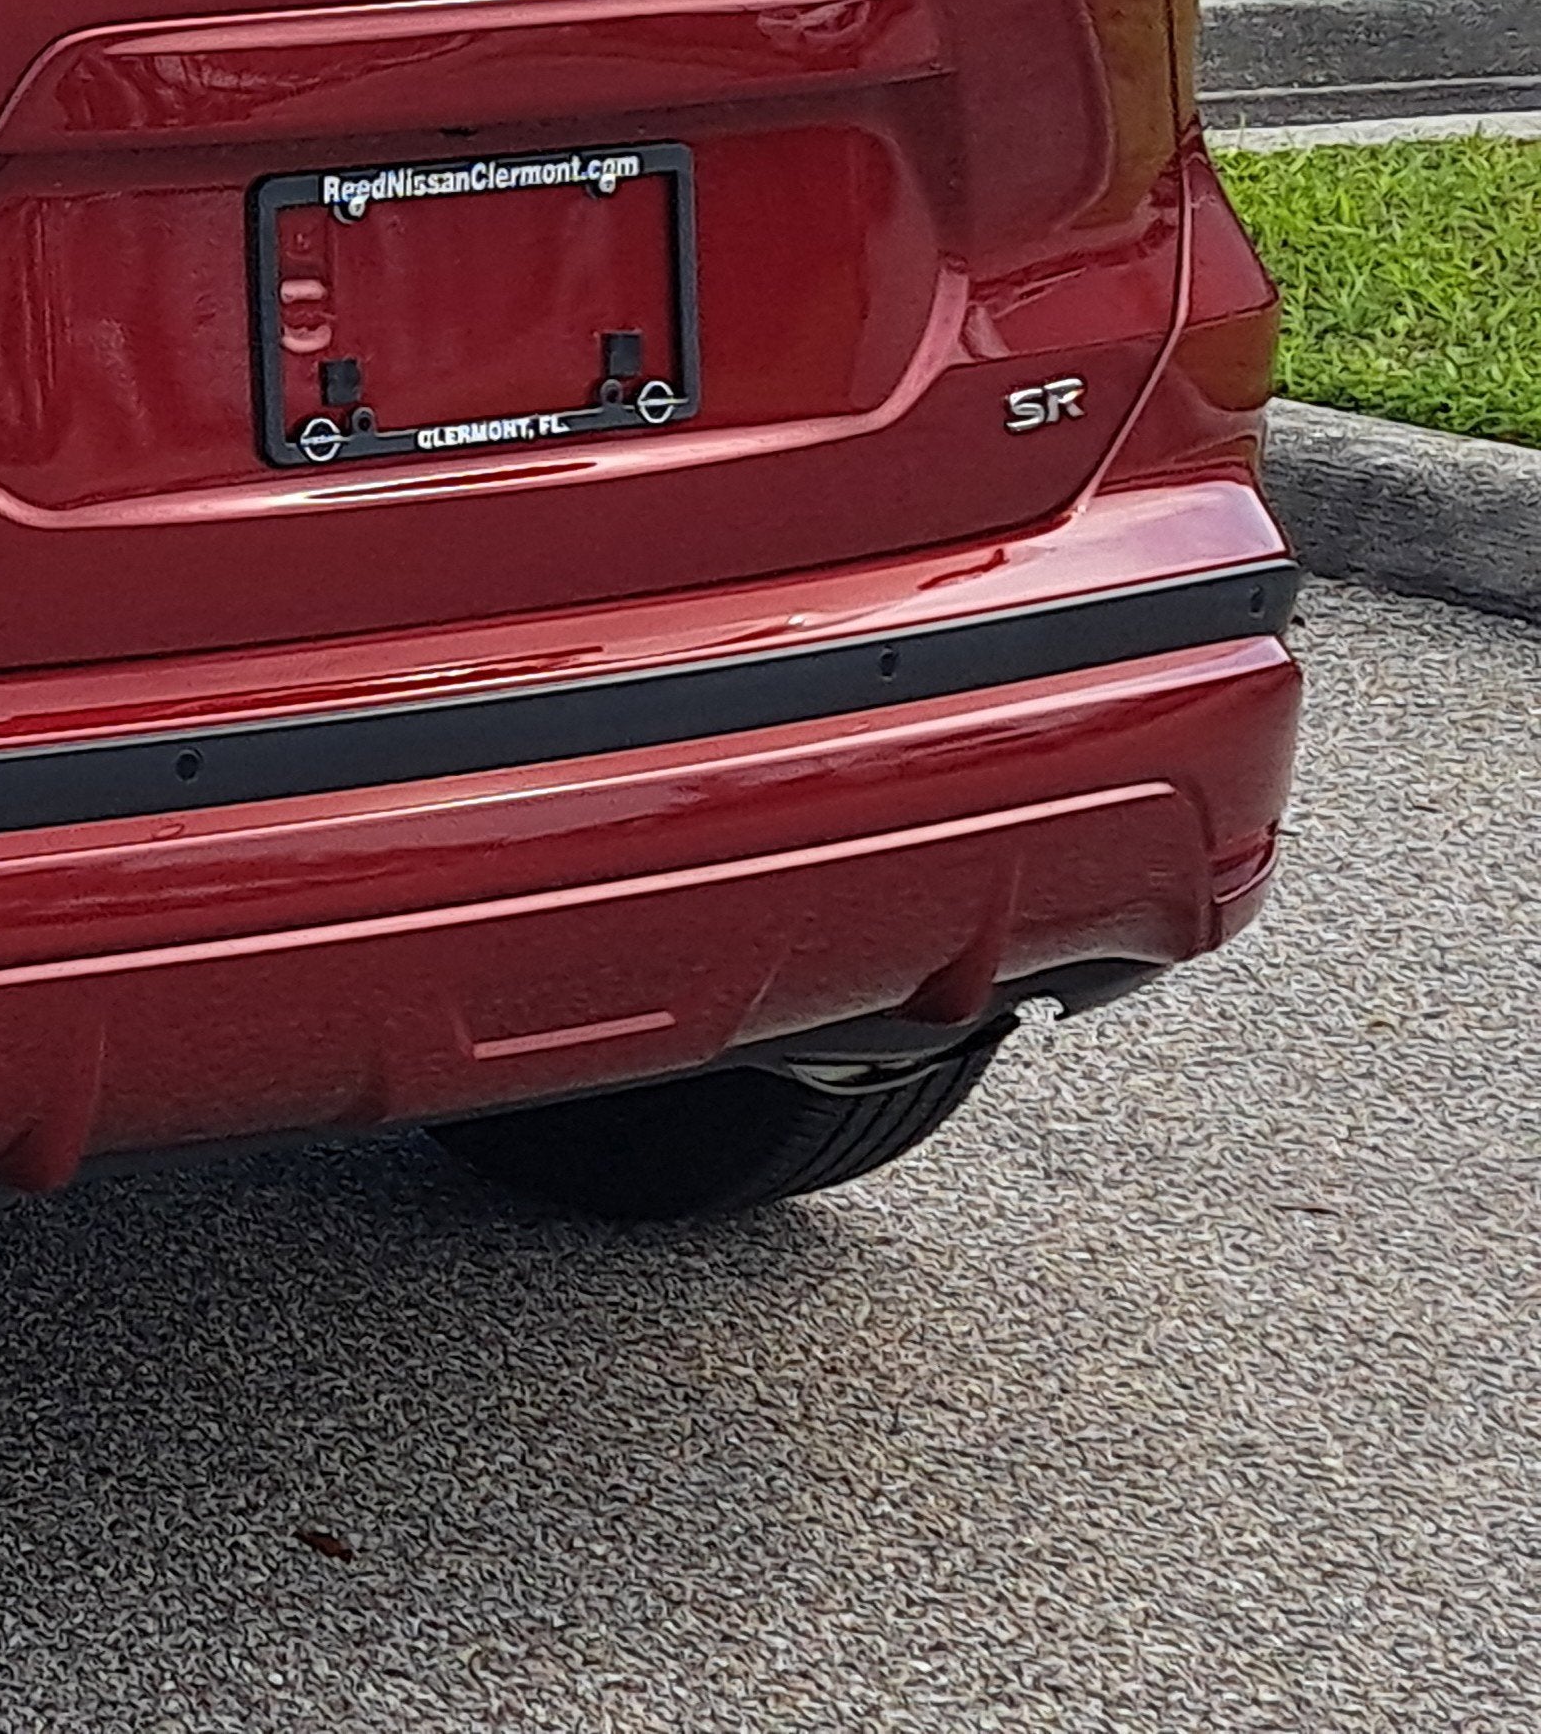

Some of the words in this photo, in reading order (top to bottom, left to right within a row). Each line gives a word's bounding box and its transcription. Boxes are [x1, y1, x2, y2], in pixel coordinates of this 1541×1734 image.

[323, 154, 641, 204] ReedNissanClermont.com
[1006, 377, 1085, 432] SR
[417, 418, 534, 450] CLERMONT,
